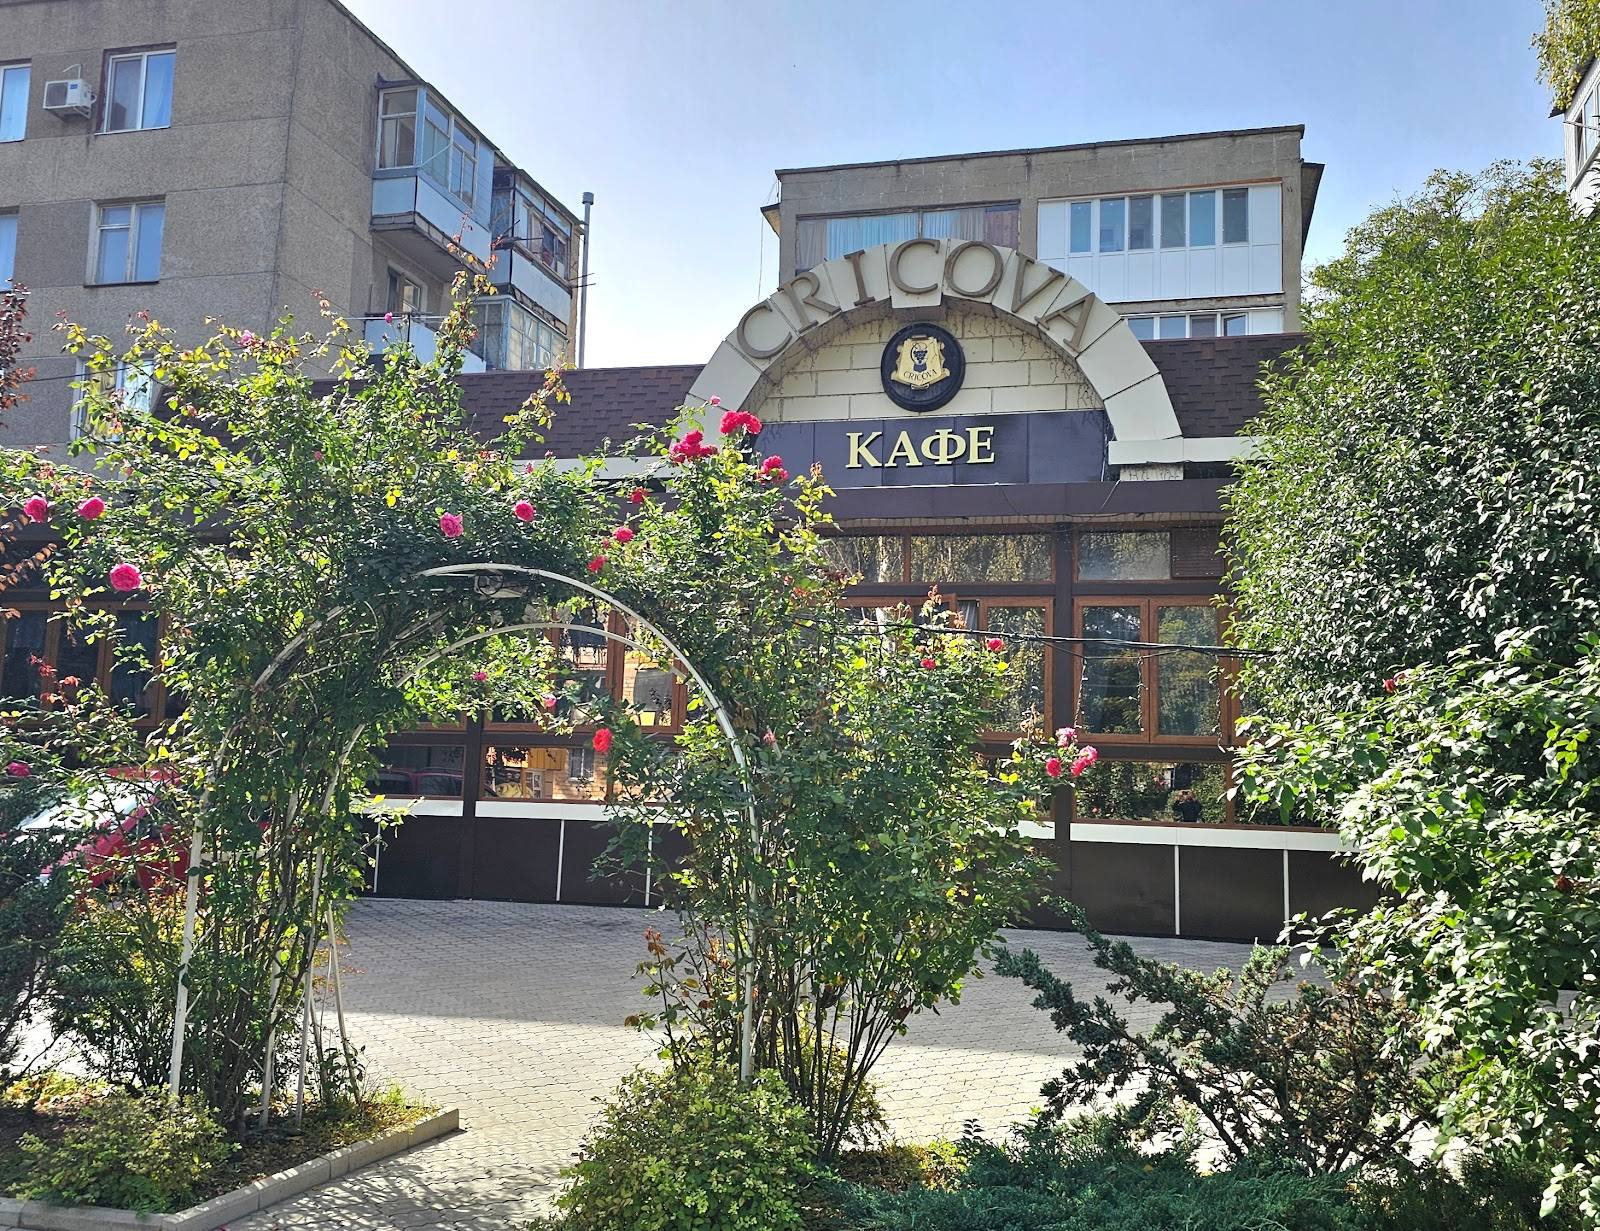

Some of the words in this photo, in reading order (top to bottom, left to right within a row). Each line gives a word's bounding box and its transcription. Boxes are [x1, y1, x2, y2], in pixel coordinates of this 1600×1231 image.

[737, 238, 1096, 359] CRICOVA
[903, 368, 938, 381] CRICOVA
[845, 426, 996, 469] КАФЕ
